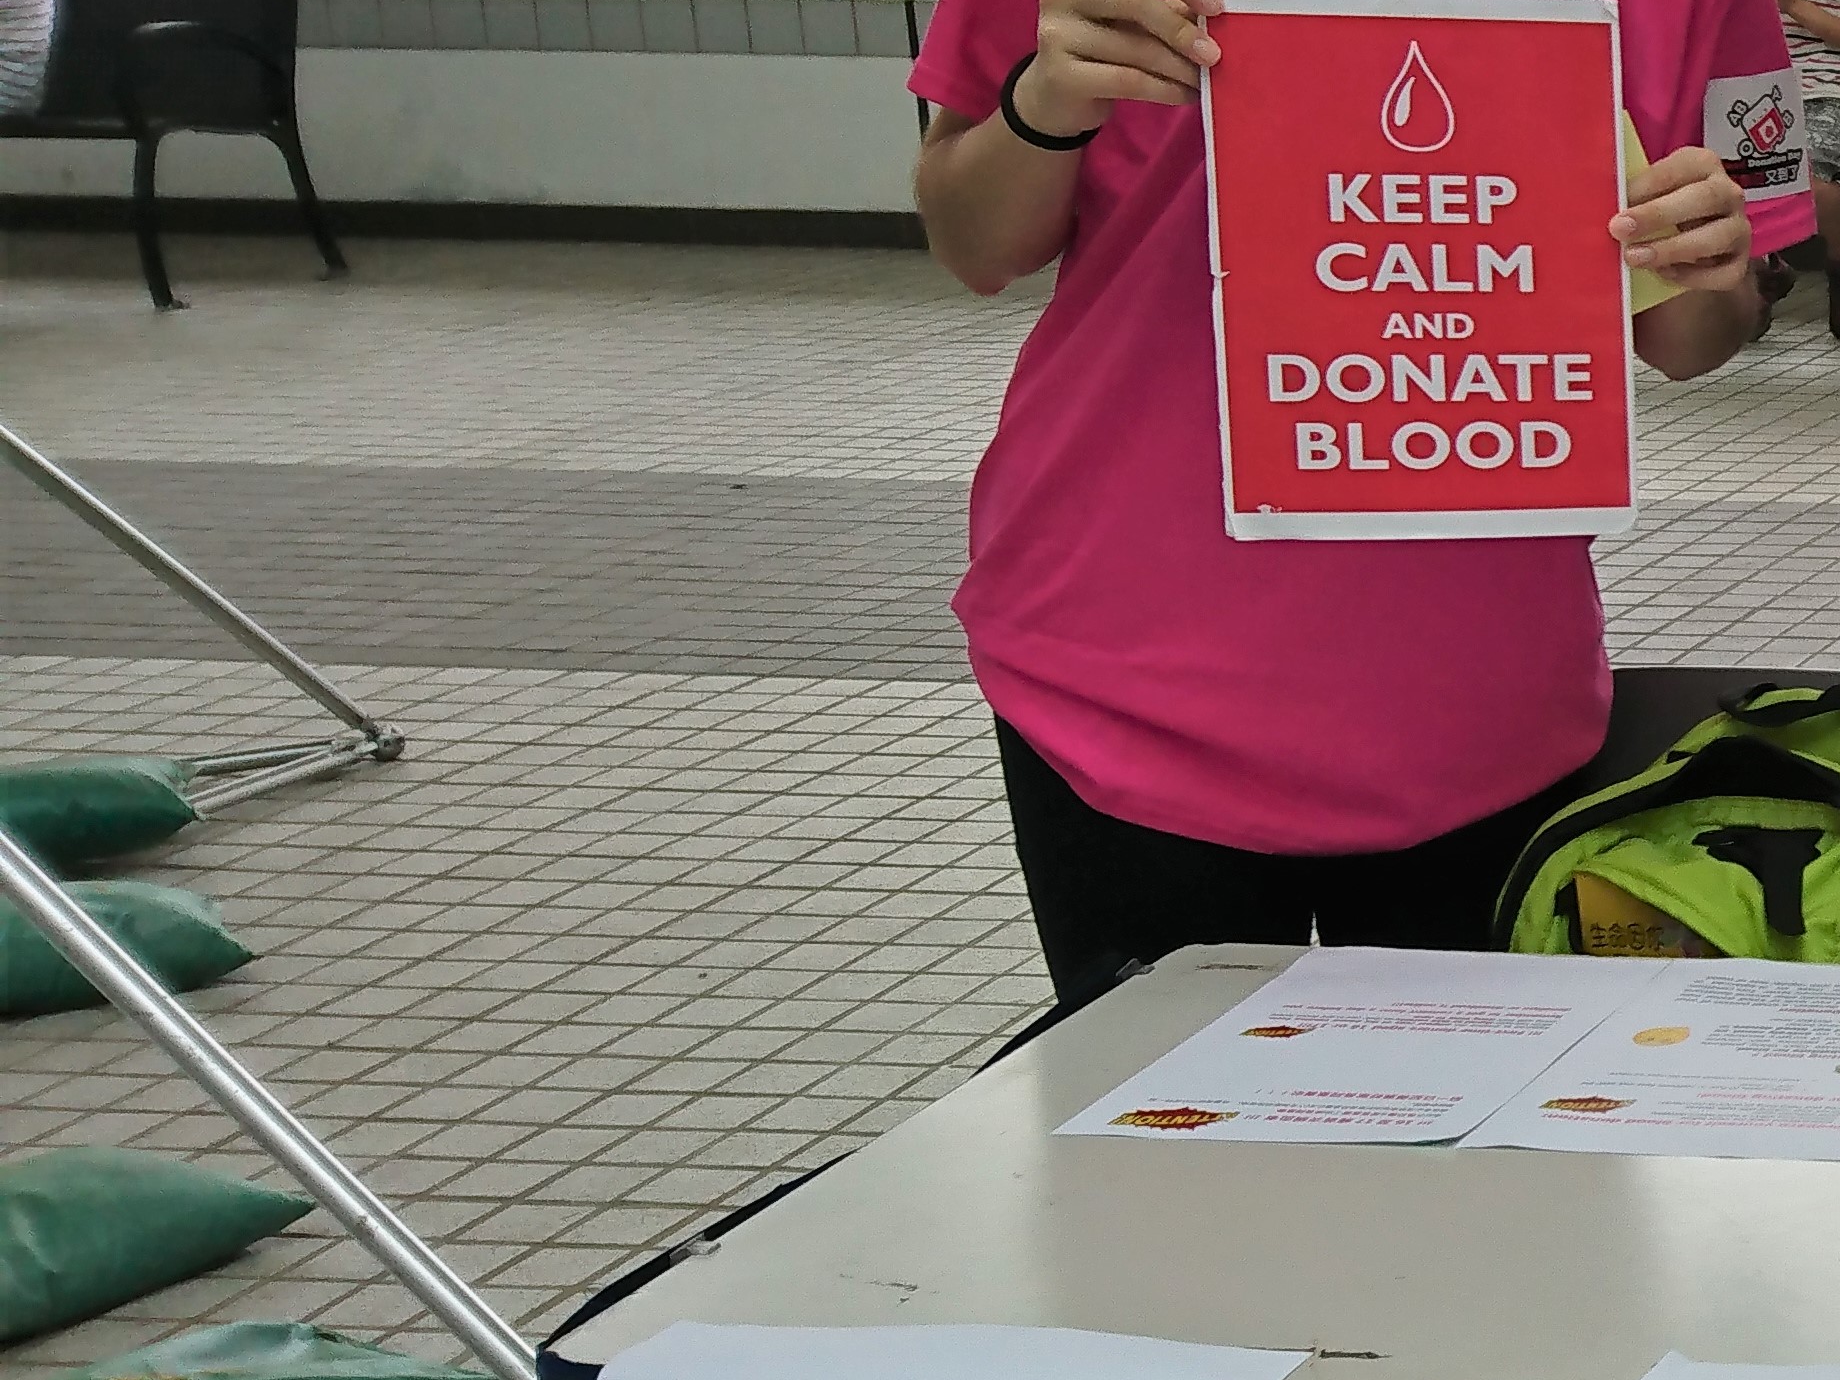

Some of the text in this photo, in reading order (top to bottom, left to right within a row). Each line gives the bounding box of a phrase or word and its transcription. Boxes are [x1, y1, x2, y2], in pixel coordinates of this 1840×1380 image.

[1327, 173, 1518, 225] KEEP
[1314, 243, 1535, 294] CALM
[1380, 313, 1475, 339] AND
[1266, 353, 1595, 403] DONATE
[1294, 421, 1573, 471] BLOOD
